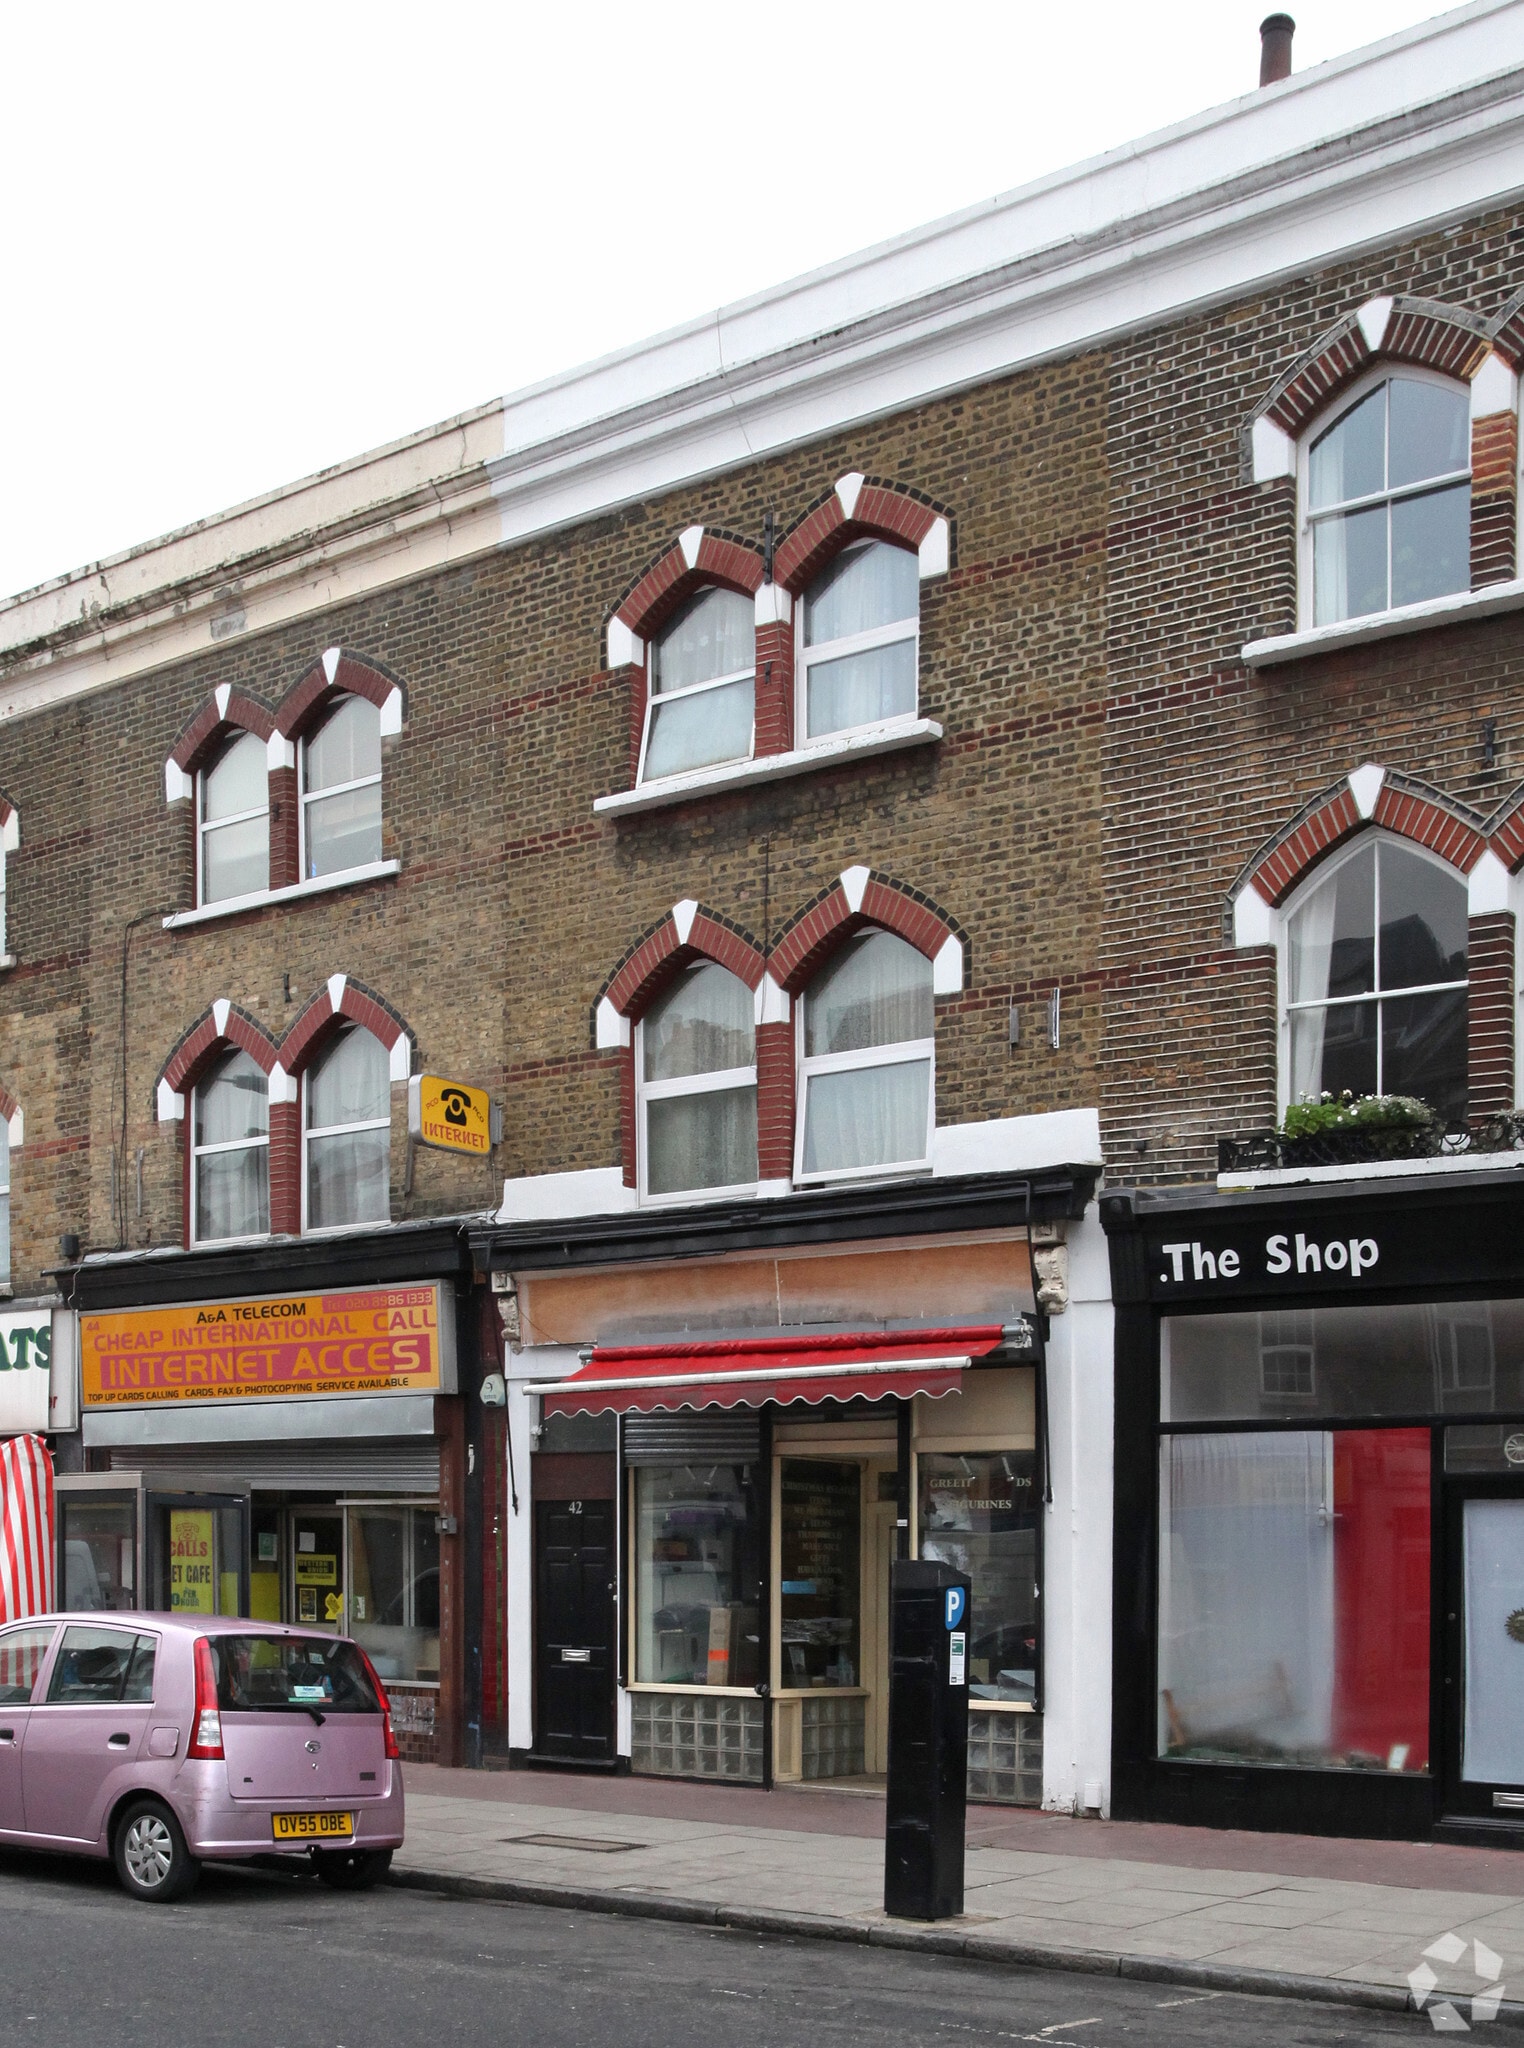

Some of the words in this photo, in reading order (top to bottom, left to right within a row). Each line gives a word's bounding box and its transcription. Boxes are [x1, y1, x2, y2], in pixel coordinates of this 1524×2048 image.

[423, 1121, 485, 1149] INTERNET
[1265, 1233, 1380, 1277] Shop
[345, 1298, 370, 1309] 020
[372, 1294, 404, 1307] 8986
[406, 1292, 432, 1304] 1333
[196, 1309, 227, 1325] A&A
[233, 1302, 306, 1321] TELECOM
[86, 1321, 100, 1331] 44
[94, 1330, 164, 1352] CHEAP
[172, 1314, 358, 1346] INTERNATIONAL
[373, 1309, 437, 1332] CALL
[109, 1349, 281, 1387] INTERNET
[291, 1339, 421, 1377] ACCES
[88, 1393, 104, 1402] TOP
[105, 1393, 116, 1401] UP
[118, 1391, 145, 1401] CARDS
[146, 1389, 179, 1400] CALLING
[217, 1386, 234, 1396] FAX
[235, 1386, 243, 1395] &
[244, 1382, 313, 1395] PHOTOCOPYING
[316, 1380, 356, 1391] SERVICE
[357, 1377, 409, 1390] AVAILABLE
[568, 1501, 583, 1514] 42
[170, 1540, 208, 1557] CALLS
[186, 1565, 211, 1583] CAFE
[948, 1591, 960, 1622] P
[279, 1816, 316, 1833] OV55
[320, 1815, 346, 1831] OBE
